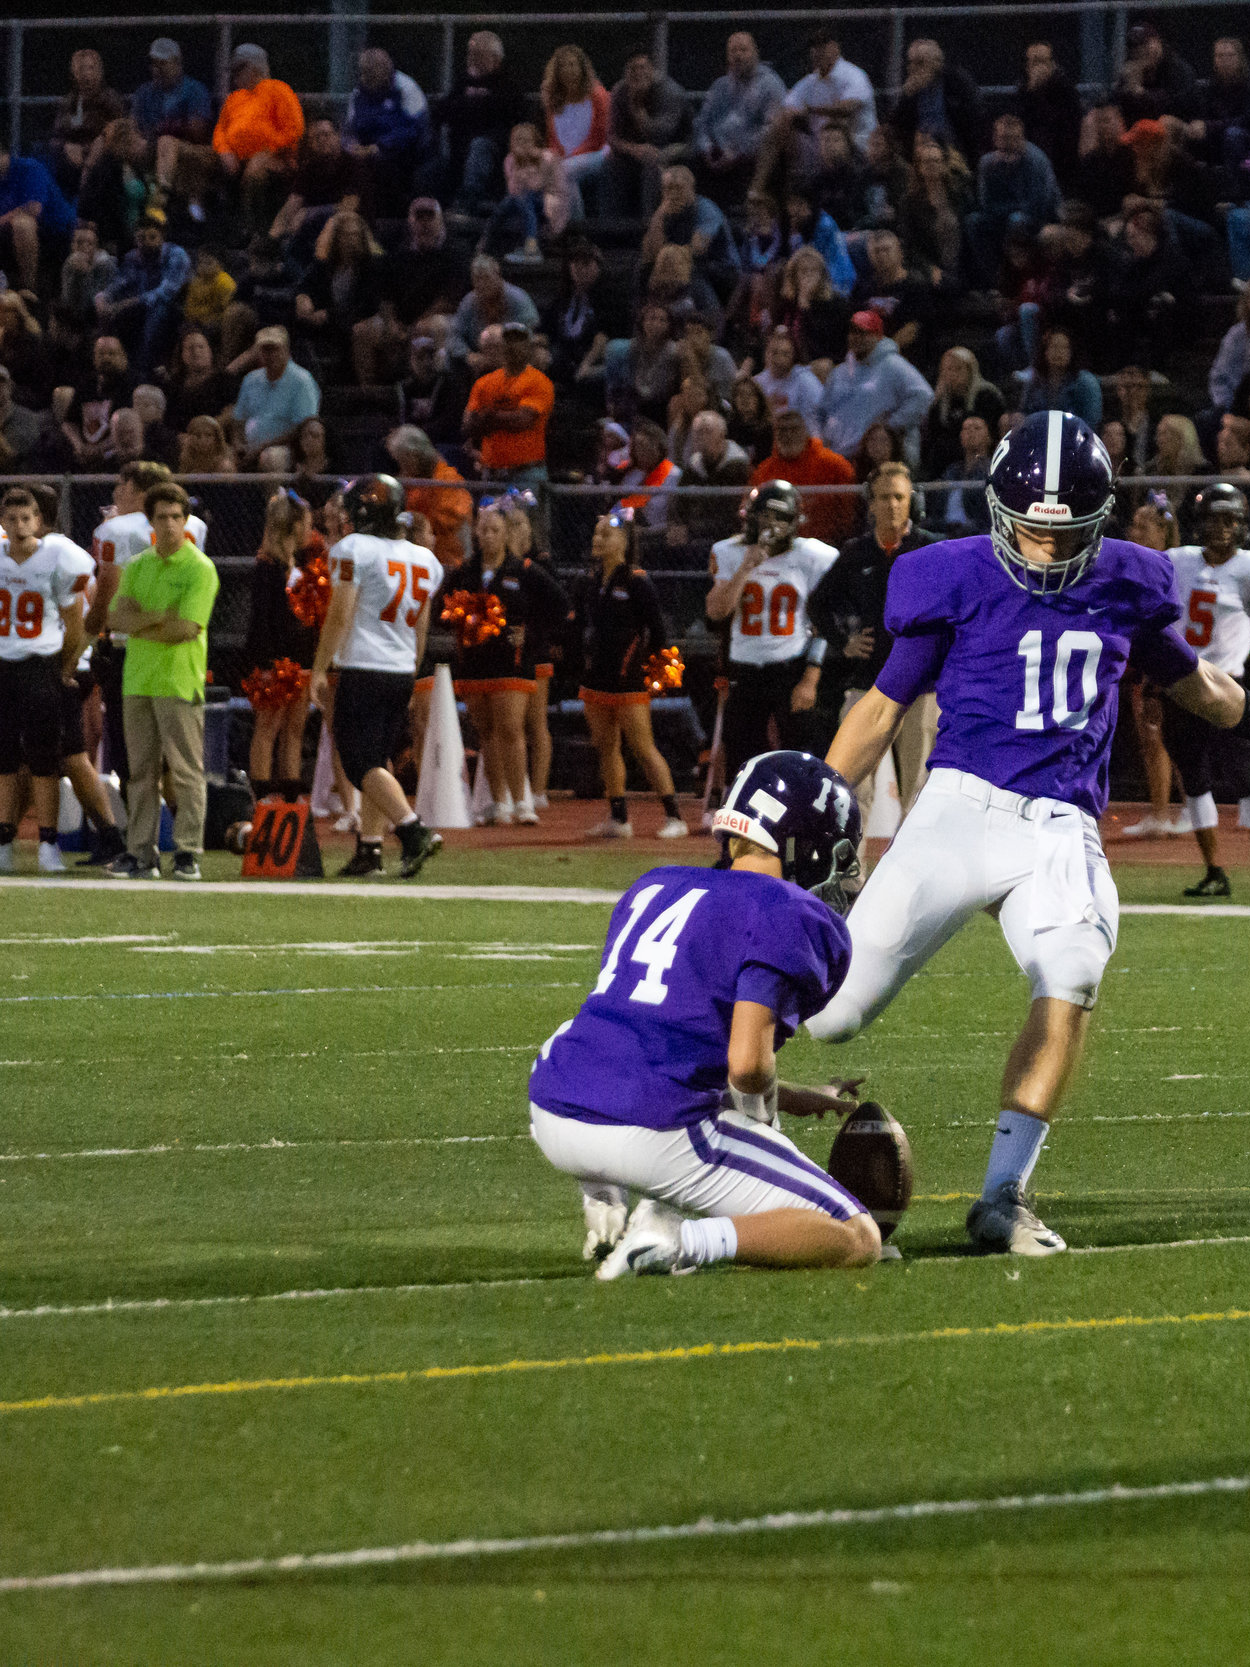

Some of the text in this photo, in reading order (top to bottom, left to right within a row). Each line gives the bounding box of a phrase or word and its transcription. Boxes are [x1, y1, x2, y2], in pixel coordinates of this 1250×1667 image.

[1034, 505, 1067, 515] Riddell
[380, 560, 429, 627] 75
[741, 582, 797, 636] 20
[1186, 590, 1216, 647] 5
[1016, 630, 1103, 730] 10
[249, 810, 300, 867] 40
[592, 884, 709, 1005] 14
